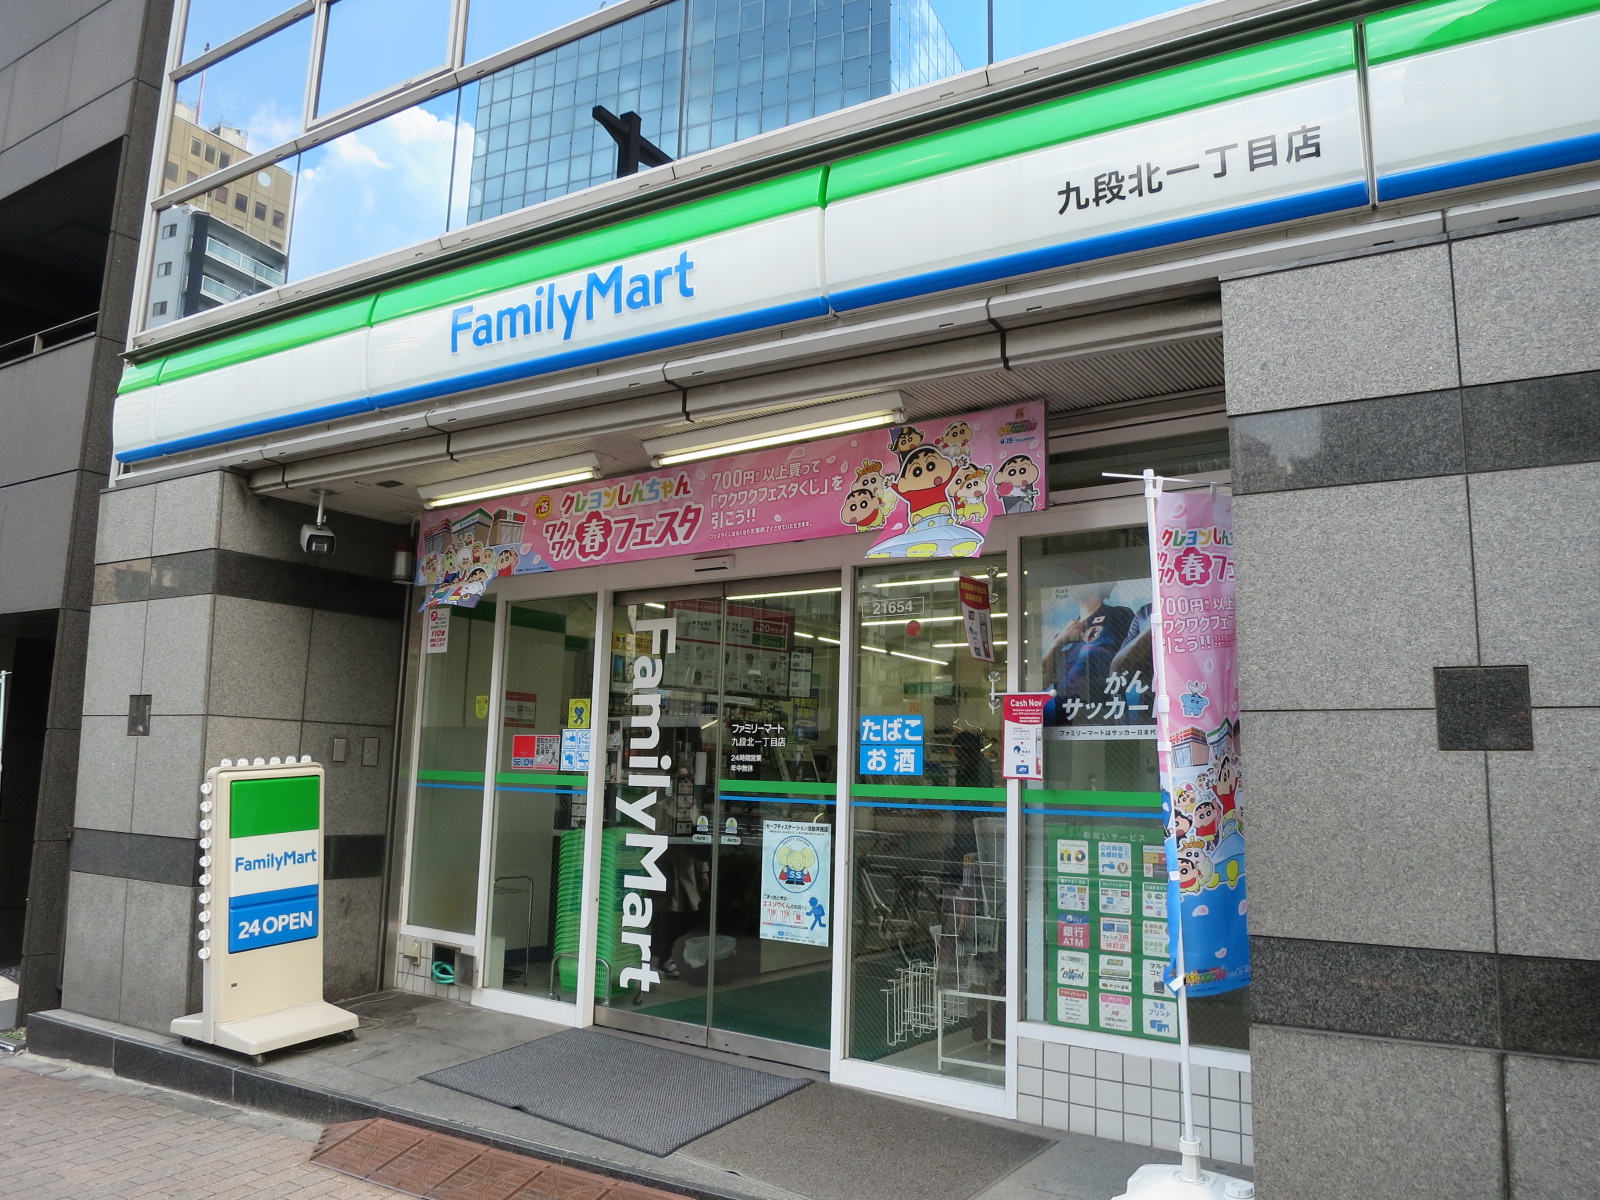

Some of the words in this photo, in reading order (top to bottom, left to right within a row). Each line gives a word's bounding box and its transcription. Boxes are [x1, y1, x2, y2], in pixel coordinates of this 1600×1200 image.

[1057, 125, 1321, 215] 九段北一丁目店
[451, 250, 695, 353] FamilyMart
[561, 474, 692, 513] クレヨンしんちゃん
[710, 475, 844, 509] 「ワクワクフェスタくじ」を
[872, 600, 914, 615] 21654
[1010, 699, 1028, 707] Cash
[731, 723, 784, 734] ファミリーマート
[862, 718, 922, 742] たばこ
[731, 737, 786, 747] 九段北一丁目店
[867, 748, 916, 772] お酒
[615, 617, 677, 992] FamilyMart
[235, 848, 317, 873] FamilyMart
[788, 871, 802, 879] SS
[238, 918, 261, 939] 24
[263, 910, 313, 934] OPEN
[1063, 925, 1083, 938] 銀行
[1063, 937, 1084, 947] ATM
